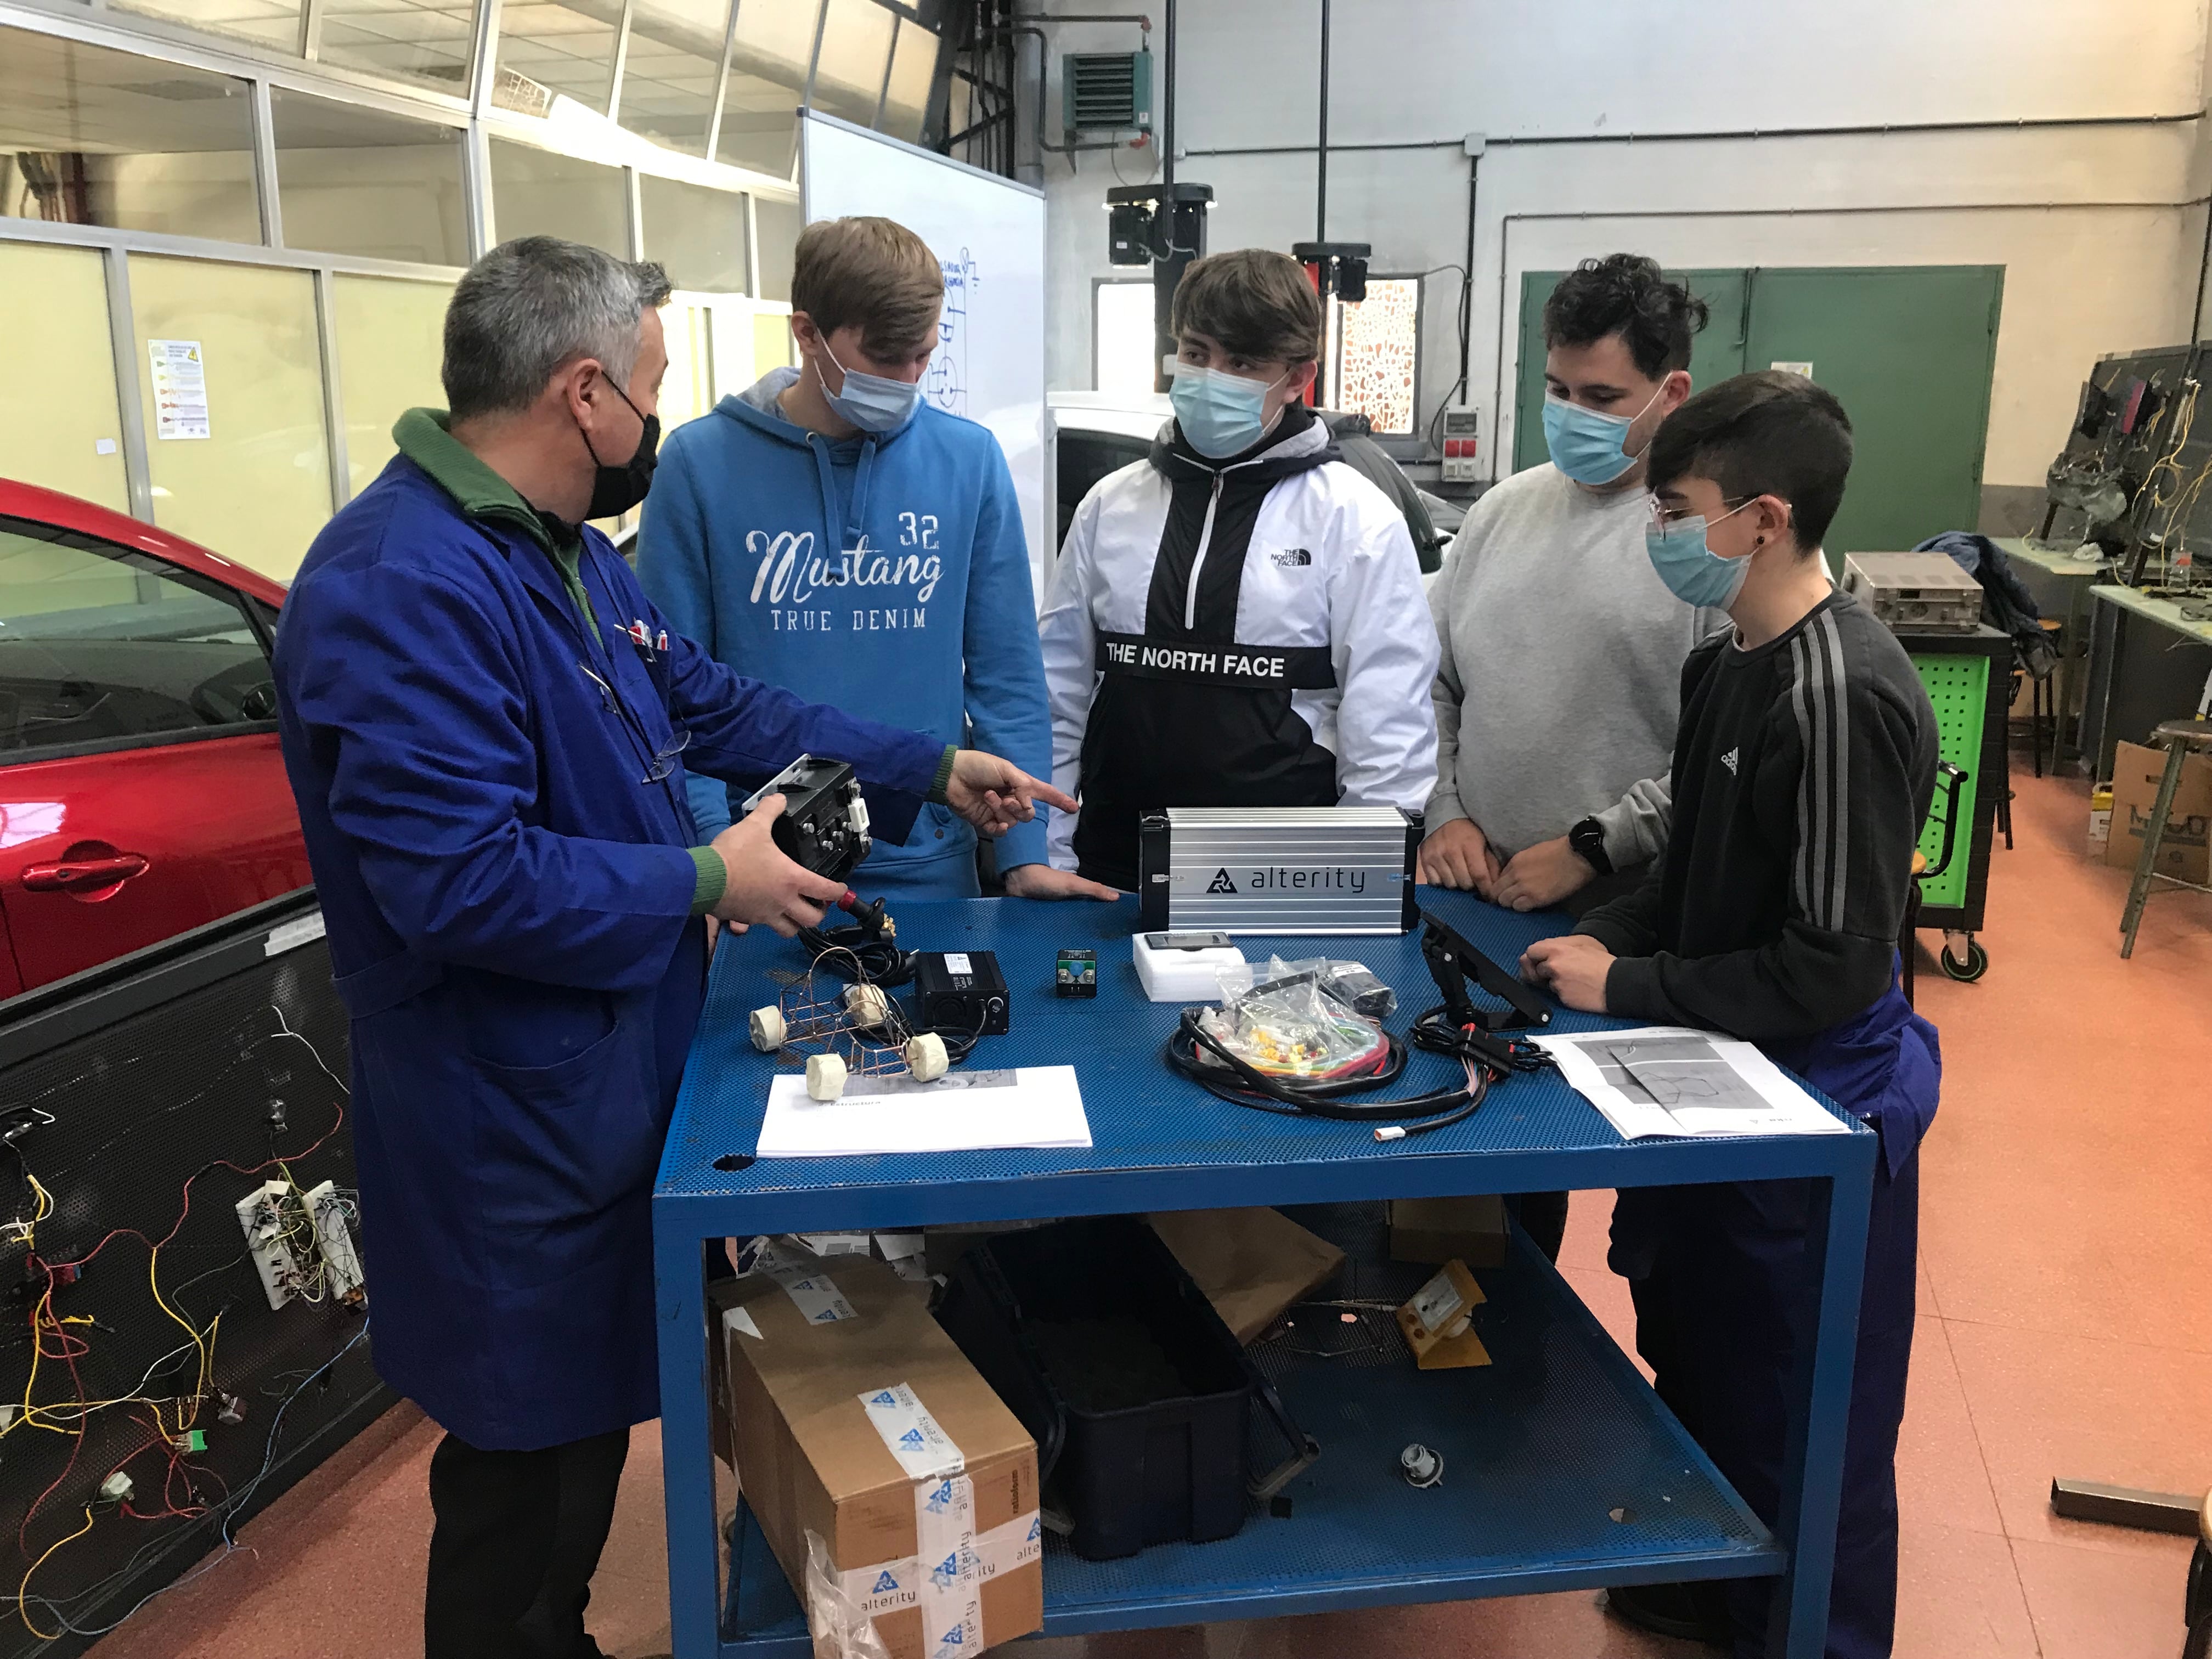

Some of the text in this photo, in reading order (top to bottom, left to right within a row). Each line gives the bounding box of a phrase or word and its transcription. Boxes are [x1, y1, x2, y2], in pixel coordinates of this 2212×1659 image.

[899, 511, 939, 550] 32
[746, 529, 946, 603] Mustang
[1271, 554, 1297, 562] NORTH
[771, 607, 926, 631] TRUE DENIM
[1106, 642, 1285, 678] THE NORTH FACE
[1251, 867, 1365, 893] alterity
[960, 1531, 972, 1581] alterity
[860, 1590, 916, 1612] alterity
